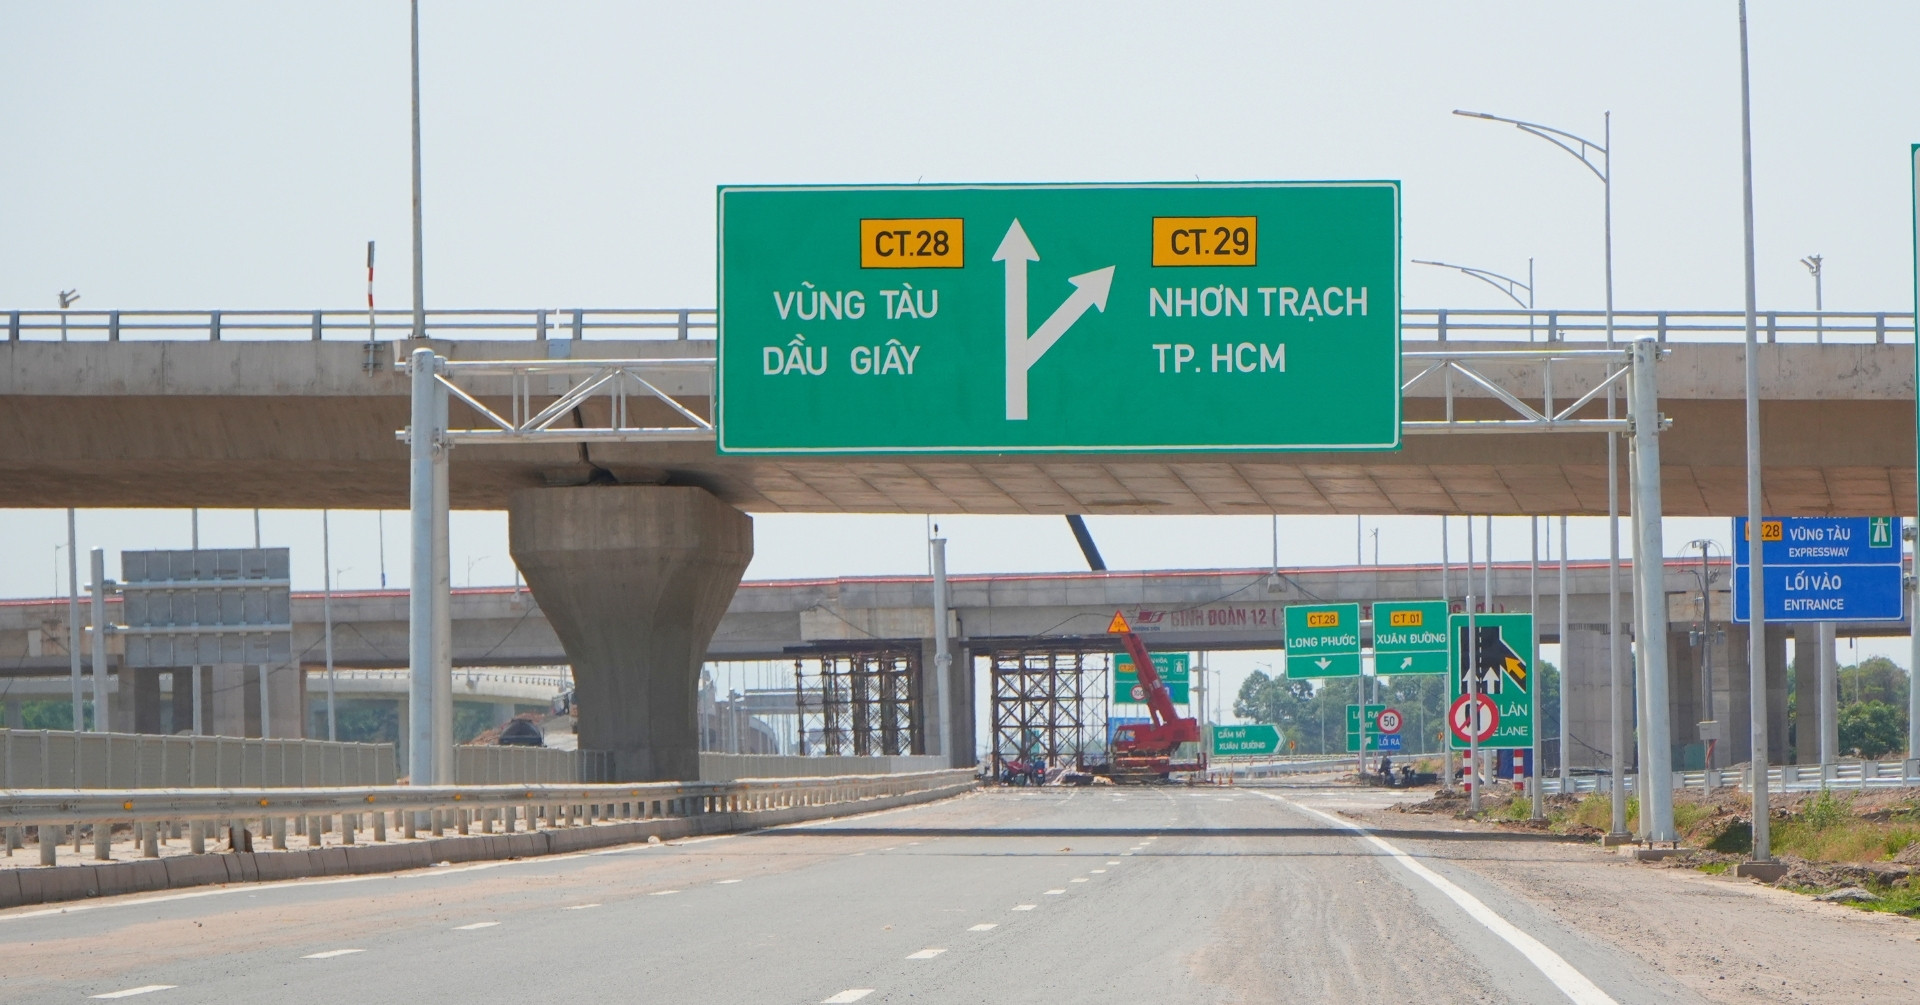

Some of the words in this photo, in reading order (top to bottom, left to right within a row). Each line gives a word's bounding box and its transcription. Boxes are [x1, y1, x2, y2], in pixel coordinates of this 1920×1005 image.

[875, 230, 950, 258] CT.28
[1171, 227, 1249, 256] CT.29
[773, 280, 866, 321] VŨNG
[879, 282, 939, 320] TÀU
[1149, 284, 1249, 317] NHƠN
[1257, 286, 1368, 323] TRẠCH
[763, 333, 828, 376] DẦU
[850, 338, 921, 376] GIÂY
[1152, 343, 1201, 373] TP.
[1211, 342, 1286, 373] HCM
[1789, 526, 1824, 541] VŨNG
[1826, 525, 1851, 541] TÀU
[1788, 547, 1850, 558] EXPRESSWAY
[1785, 570, 1809, 591] LỐI
[1811, 572, 1842, 591] VÀO
[1784, 598, 1844, 611] ENTRANCE
[1251, 609, 1267, 625] 12
[1309, 615, 1336, 625] CT.28
[1289, 637, 1318, 649] LONG
[1320, 633, 1356, 647] PHƯỚC
[1410, 631, 1446, 644] ĐƯỜNG
[1500, 701, 1528, 717] LÀN
[1383, 715, 1395, 727] 50
[1500, 726, 1528, 736] LANE
[1391, 738, 1400, 746] RA
